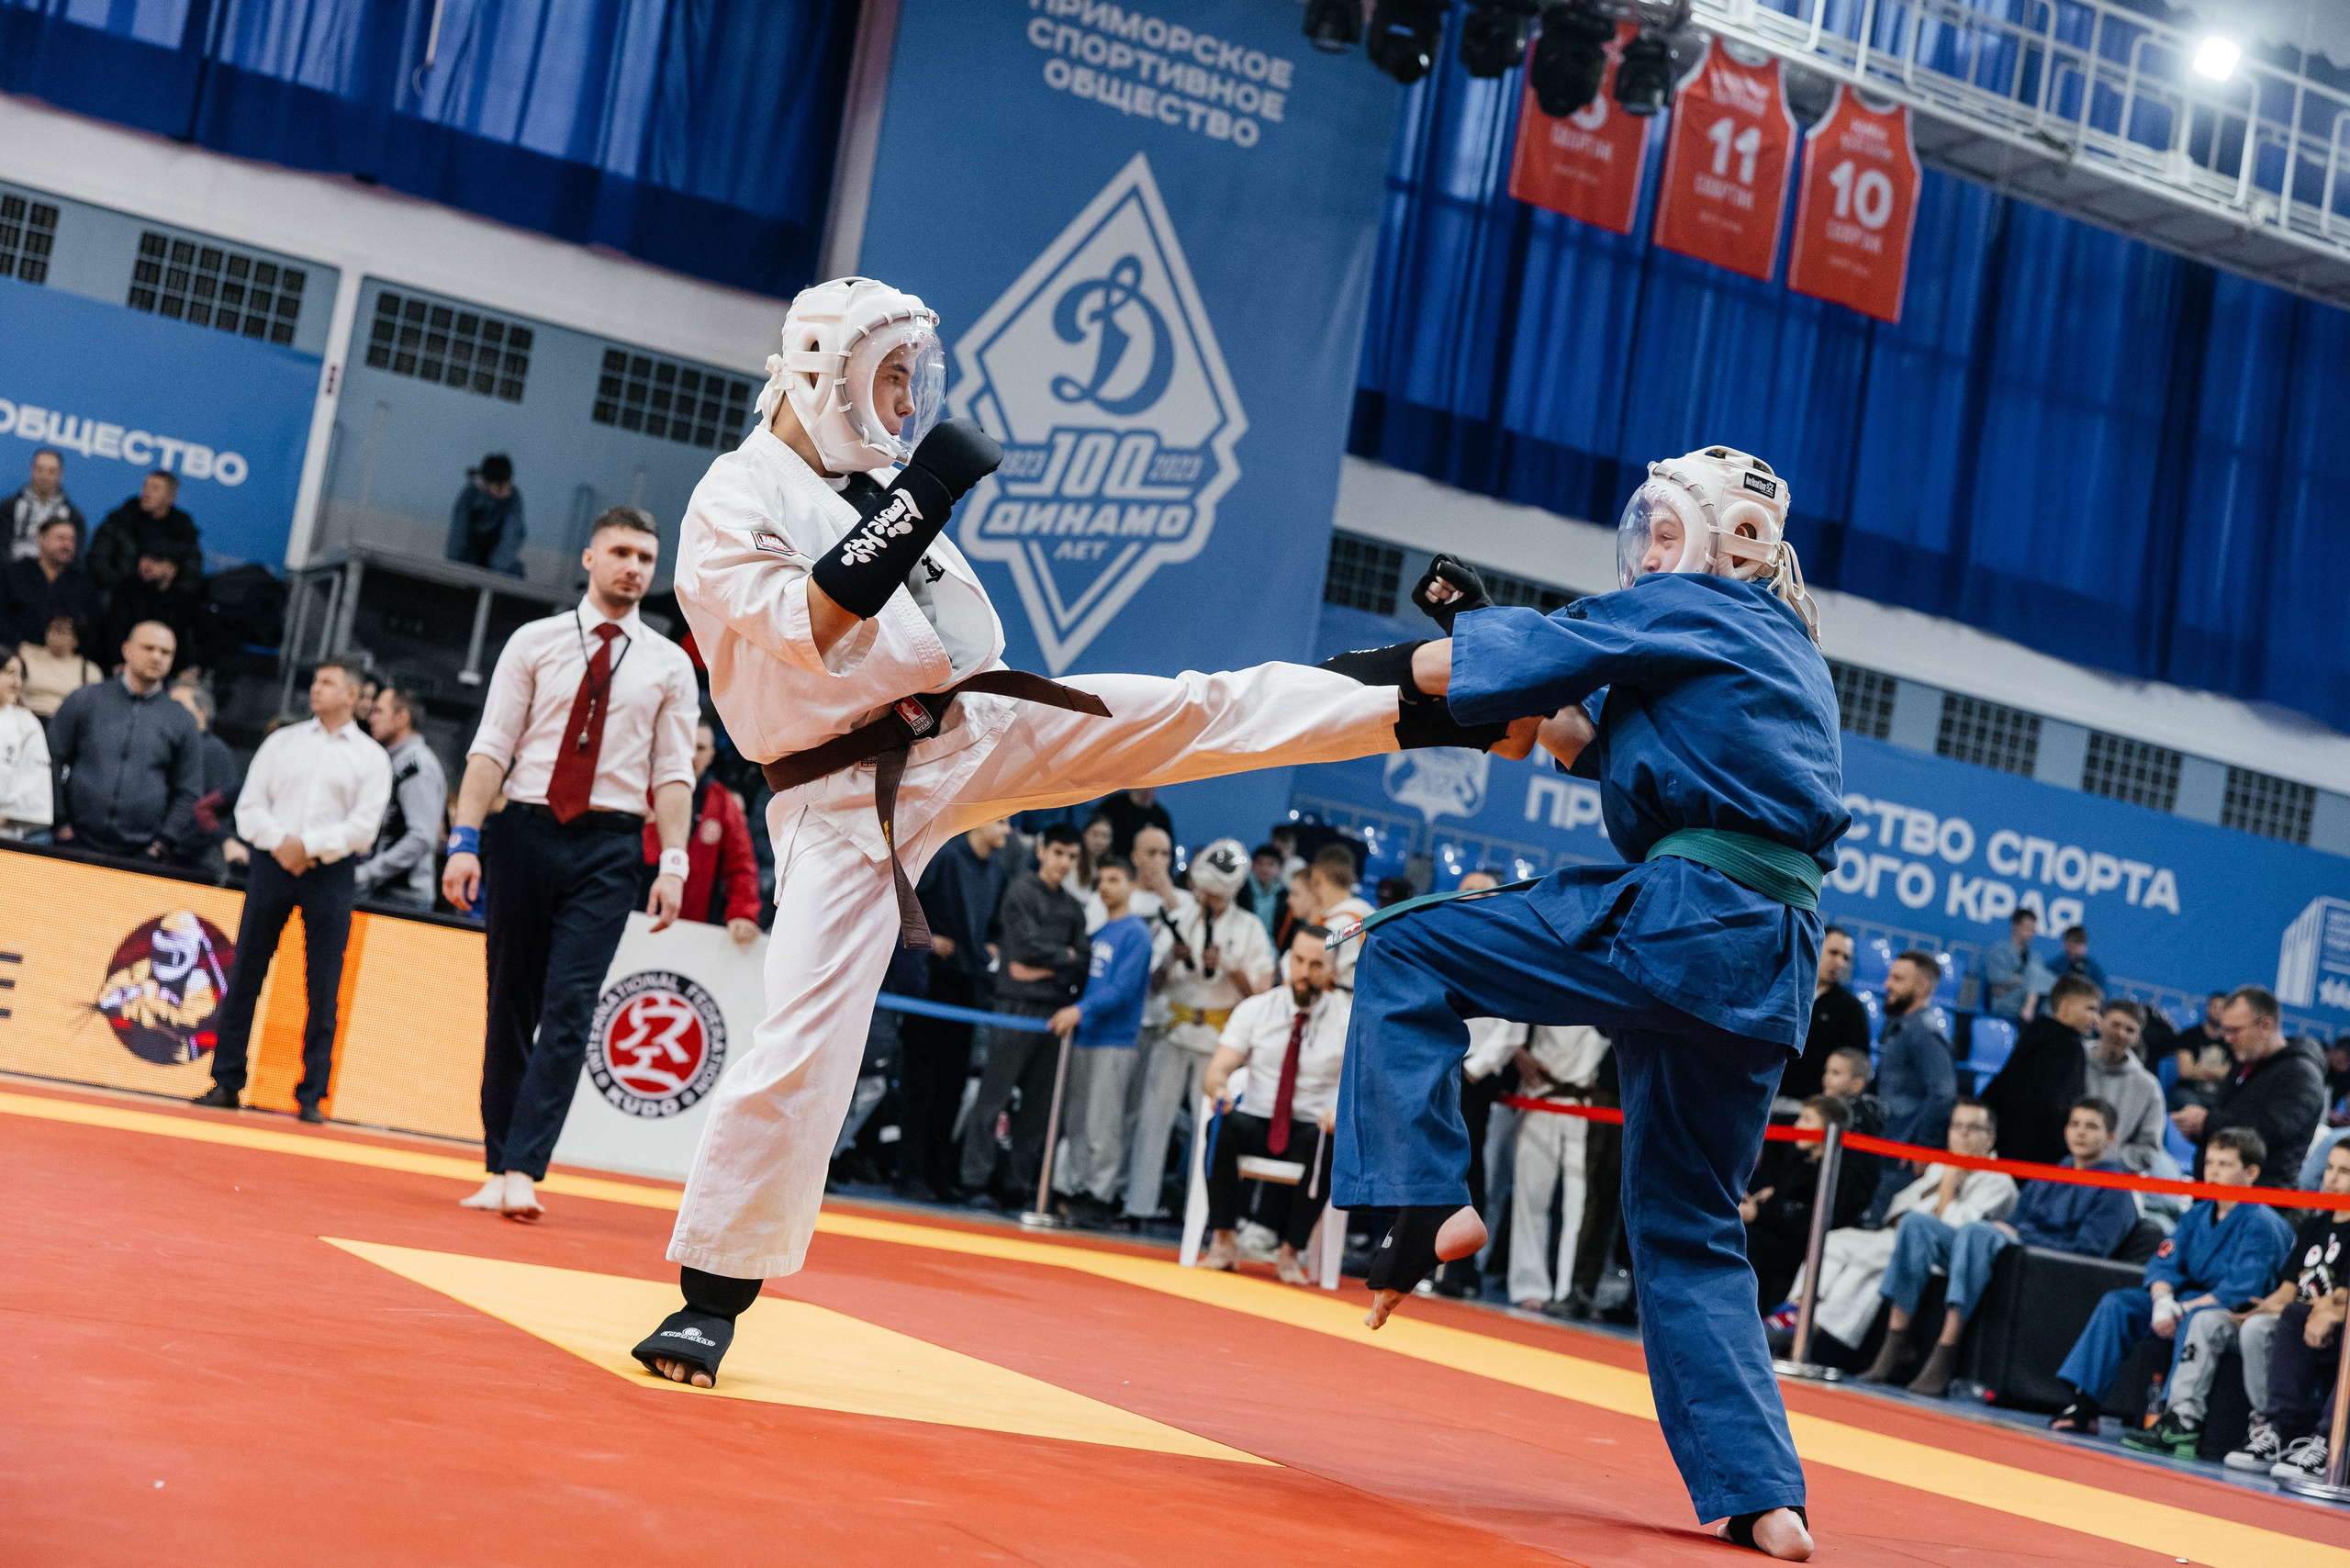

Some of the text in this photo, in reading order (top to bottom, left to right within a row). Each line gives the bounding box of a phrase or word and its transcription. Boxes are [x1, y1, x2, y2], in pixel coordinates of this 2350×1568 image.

[1026, 17, 1286, 122] СПОРТИВНОЕ
[1029, 0, 1293, 90] РИМОРСКОЕ
[1043, 58, 1260, 148] ОБЩЕСТВО
[1707, 117, 1762, 185] 11
[1829, 160, 1895, 230] 10
[1007, 430, 1192, 499] 100
[983, 500, 1192, 540] ДИНАМО
[1822, 846, 2086, 939] ОГО КРАЯ
[1841, 792, 2182, 915] СТВО СПОРТА
[605, 1086, 681, 1118] KUDO
